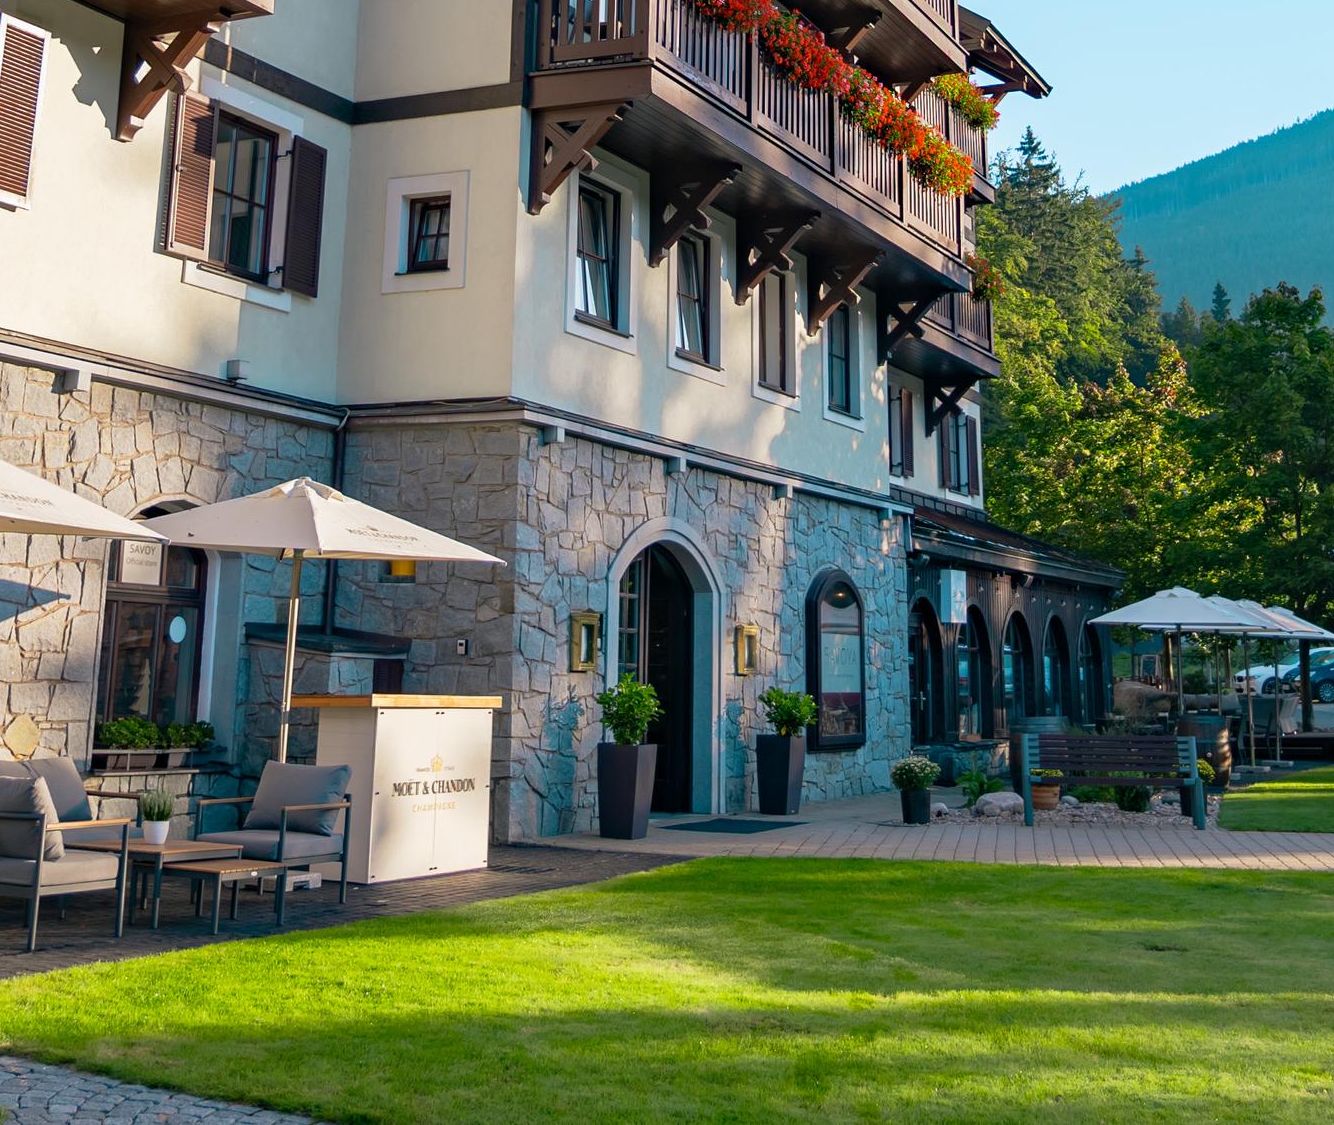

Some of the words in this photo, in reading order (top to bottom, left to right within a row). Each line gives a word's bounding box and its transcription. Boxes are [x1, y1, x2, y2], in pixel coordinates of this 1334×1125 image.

[130, 543, 157, 555] SAVOY
[422, 781, 429, 794] &
[431, 778, 476, 794] CHANDON
